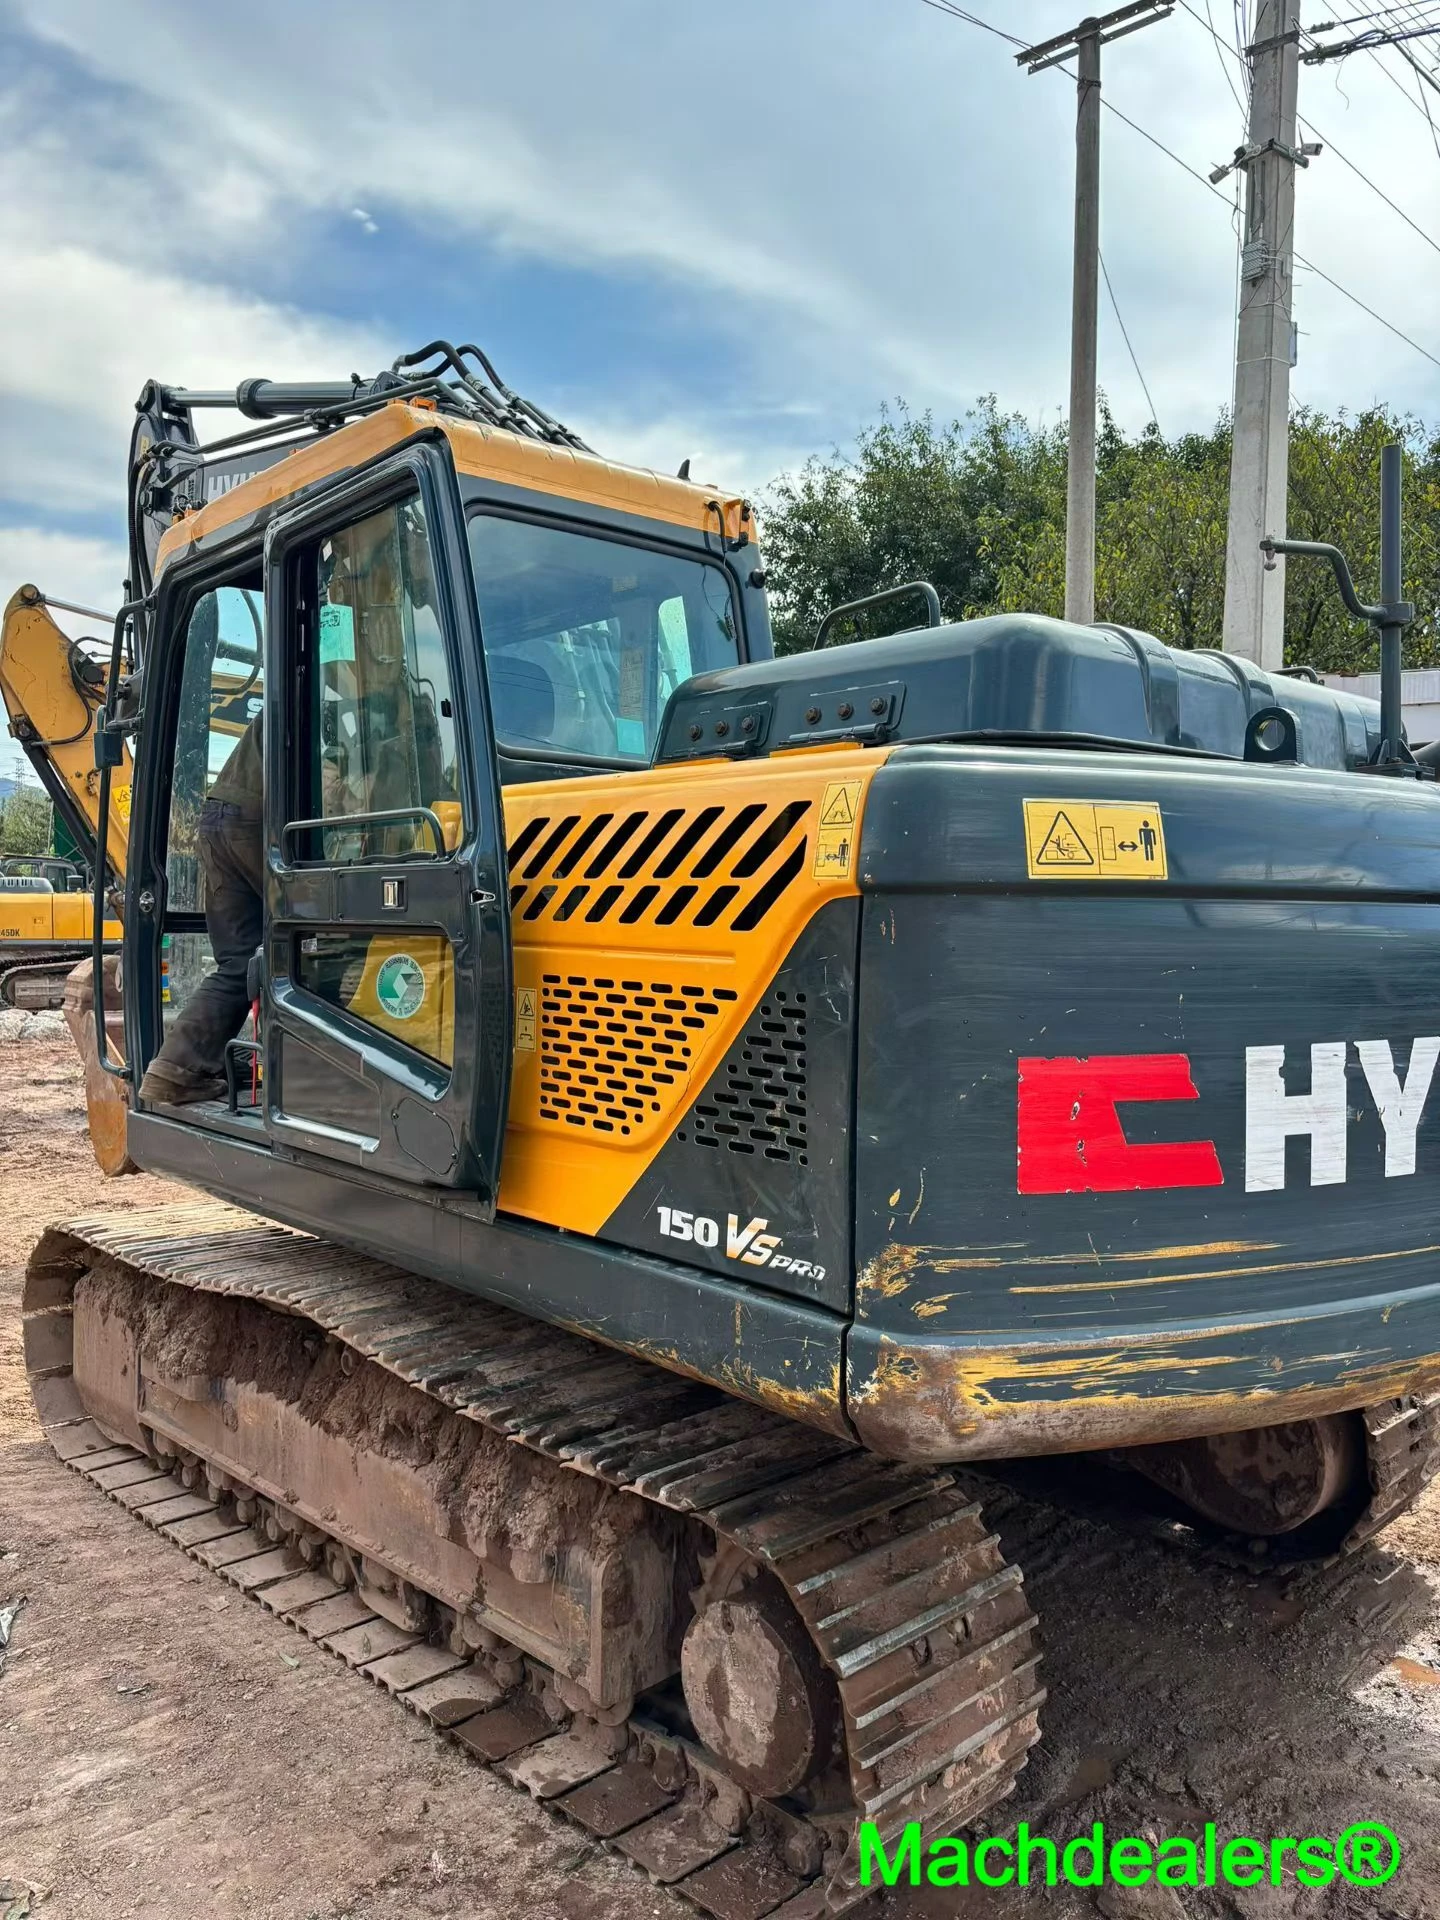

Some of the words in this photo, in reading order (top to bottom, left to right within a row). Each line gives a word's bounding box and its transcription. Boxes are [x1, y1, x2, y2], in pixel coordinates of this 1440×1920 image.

[1245, 1036, 1440, 1192] HY
[657, 1206, 719, 1247] 150
[767, 1254, 826, 1281] PRO
